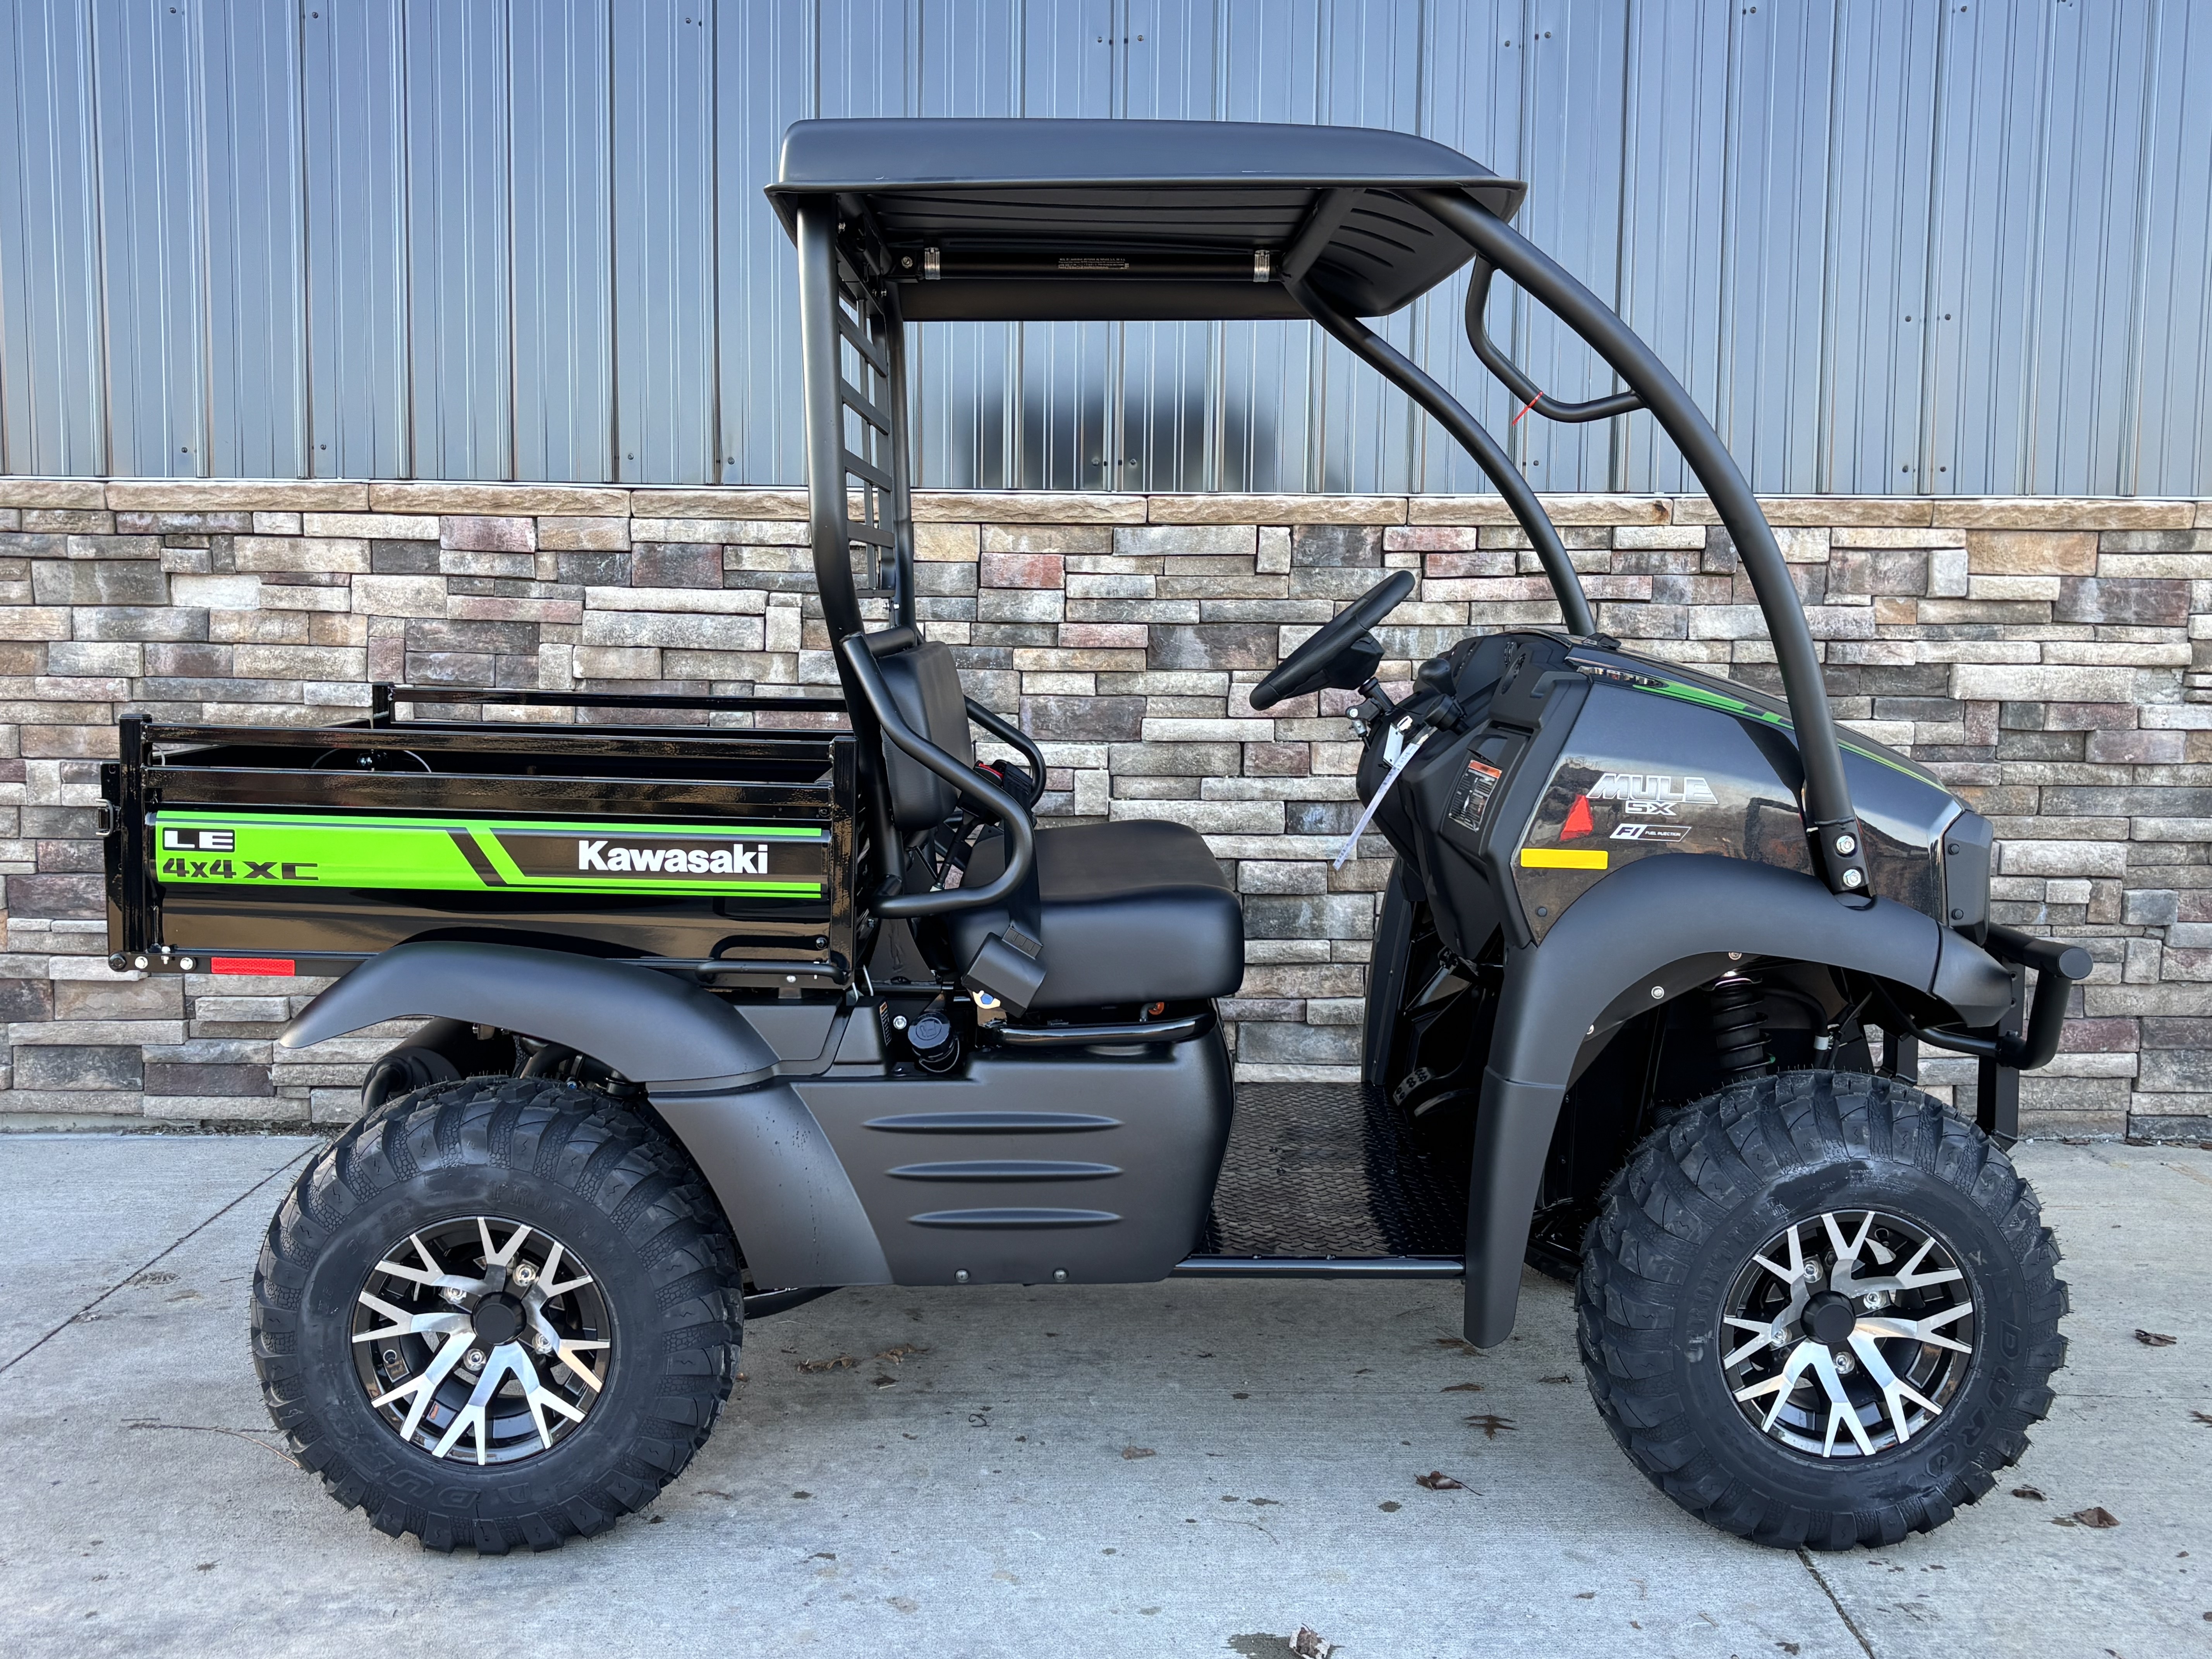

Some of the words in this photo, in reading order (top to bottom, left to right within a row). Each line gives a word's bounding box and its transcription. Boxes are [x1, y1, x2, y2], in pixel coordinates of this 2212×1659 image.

[1586, 773, 1718, 804] MULE
[1625, 800, 1678, 815] SX
[165, 830, 233, 849] LE
[1616, 827, 1641, 836] FI
[163, 858, 236, 878] 4x4
[242, 861, 319, 880] XC
[579, 840, 768, 874] Kawasaki
[1926, 1320, 2022, 1477] DURO
[325, 1406, 479, 1508] DURO
